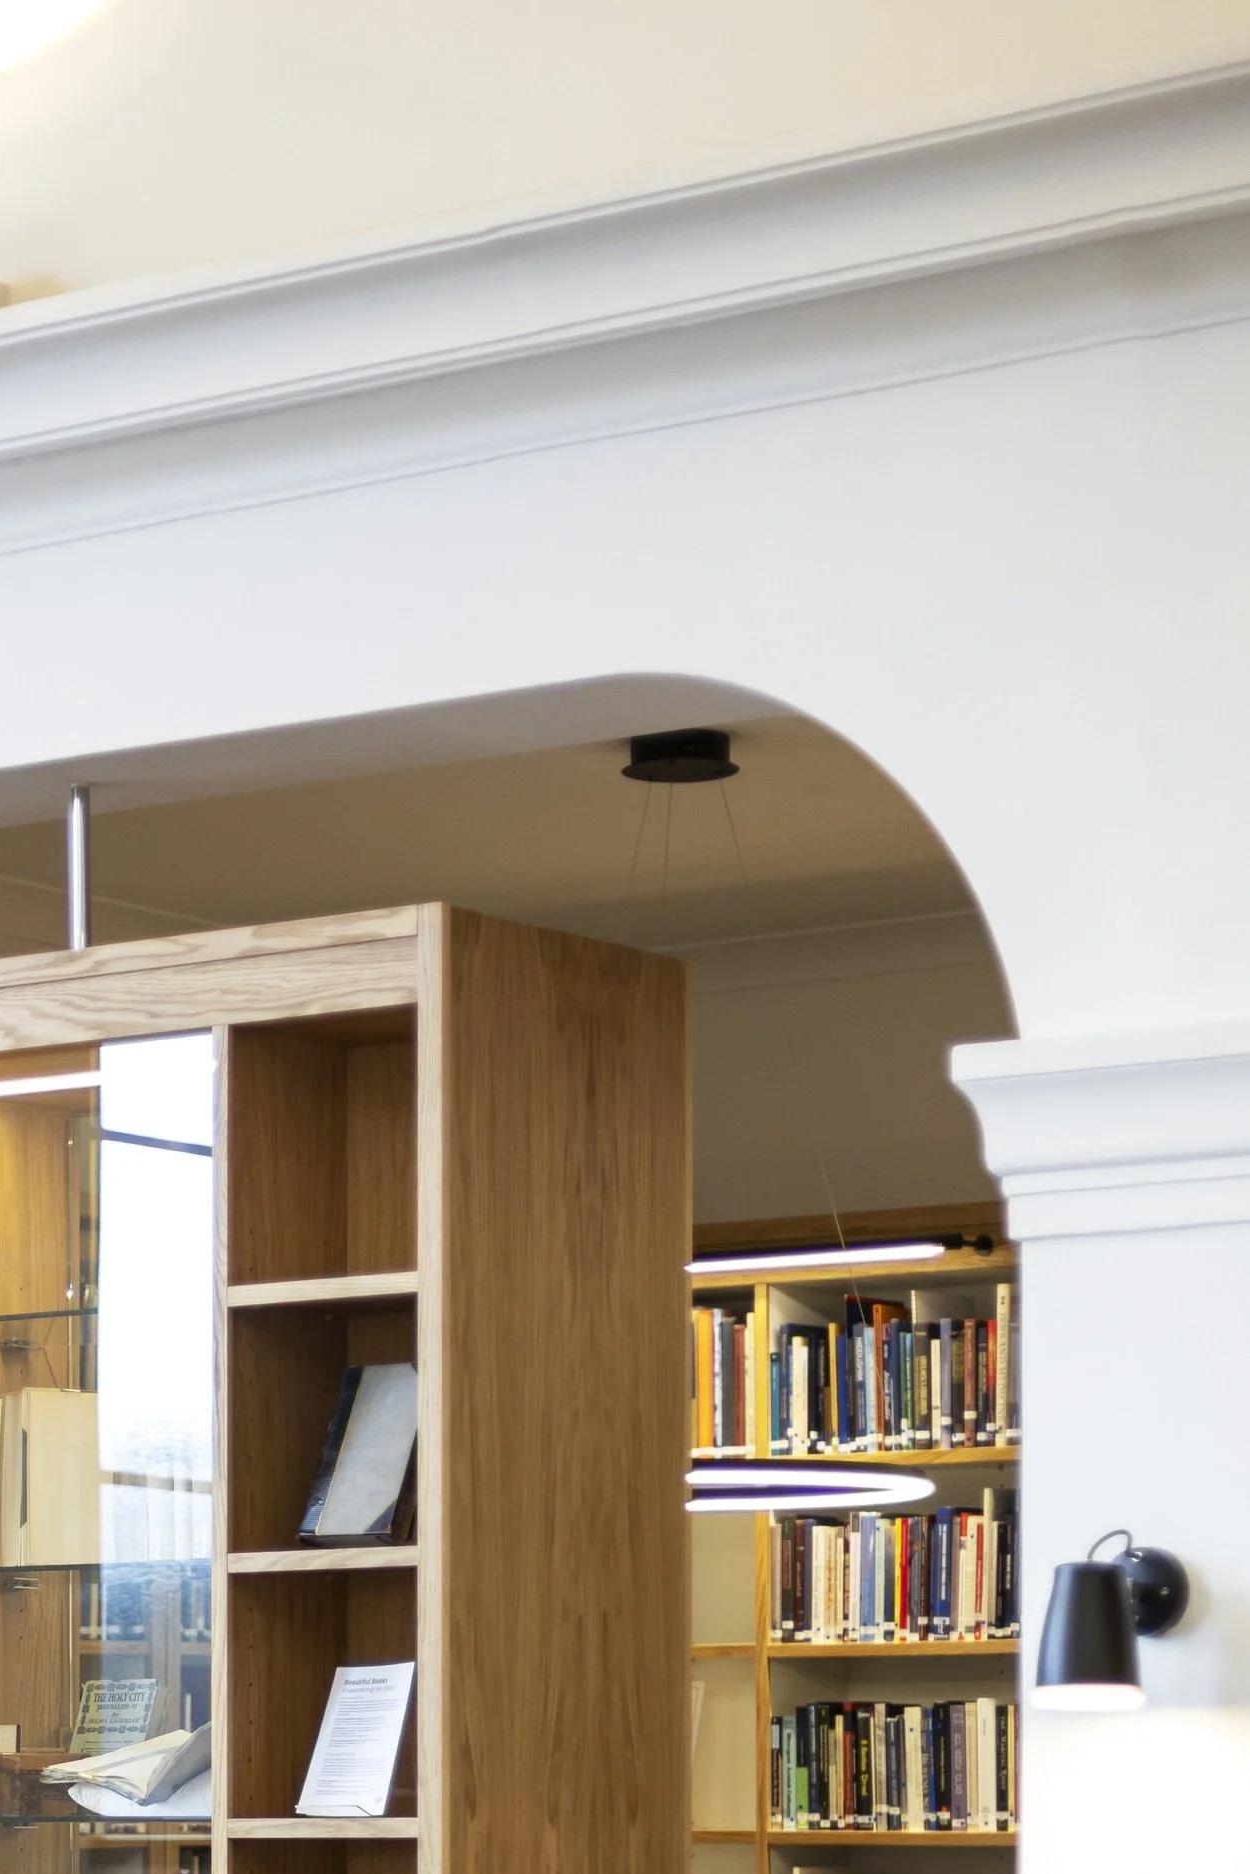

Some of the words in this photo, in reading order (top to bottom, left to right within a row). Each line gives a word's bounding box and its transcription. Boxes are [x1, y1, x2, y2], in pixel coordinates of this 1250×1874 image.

[93, 1692, 108, 1702] THE
[108, 1692, 129, 1702] HOLY
[129, 1691, 147, 1702] CITY
